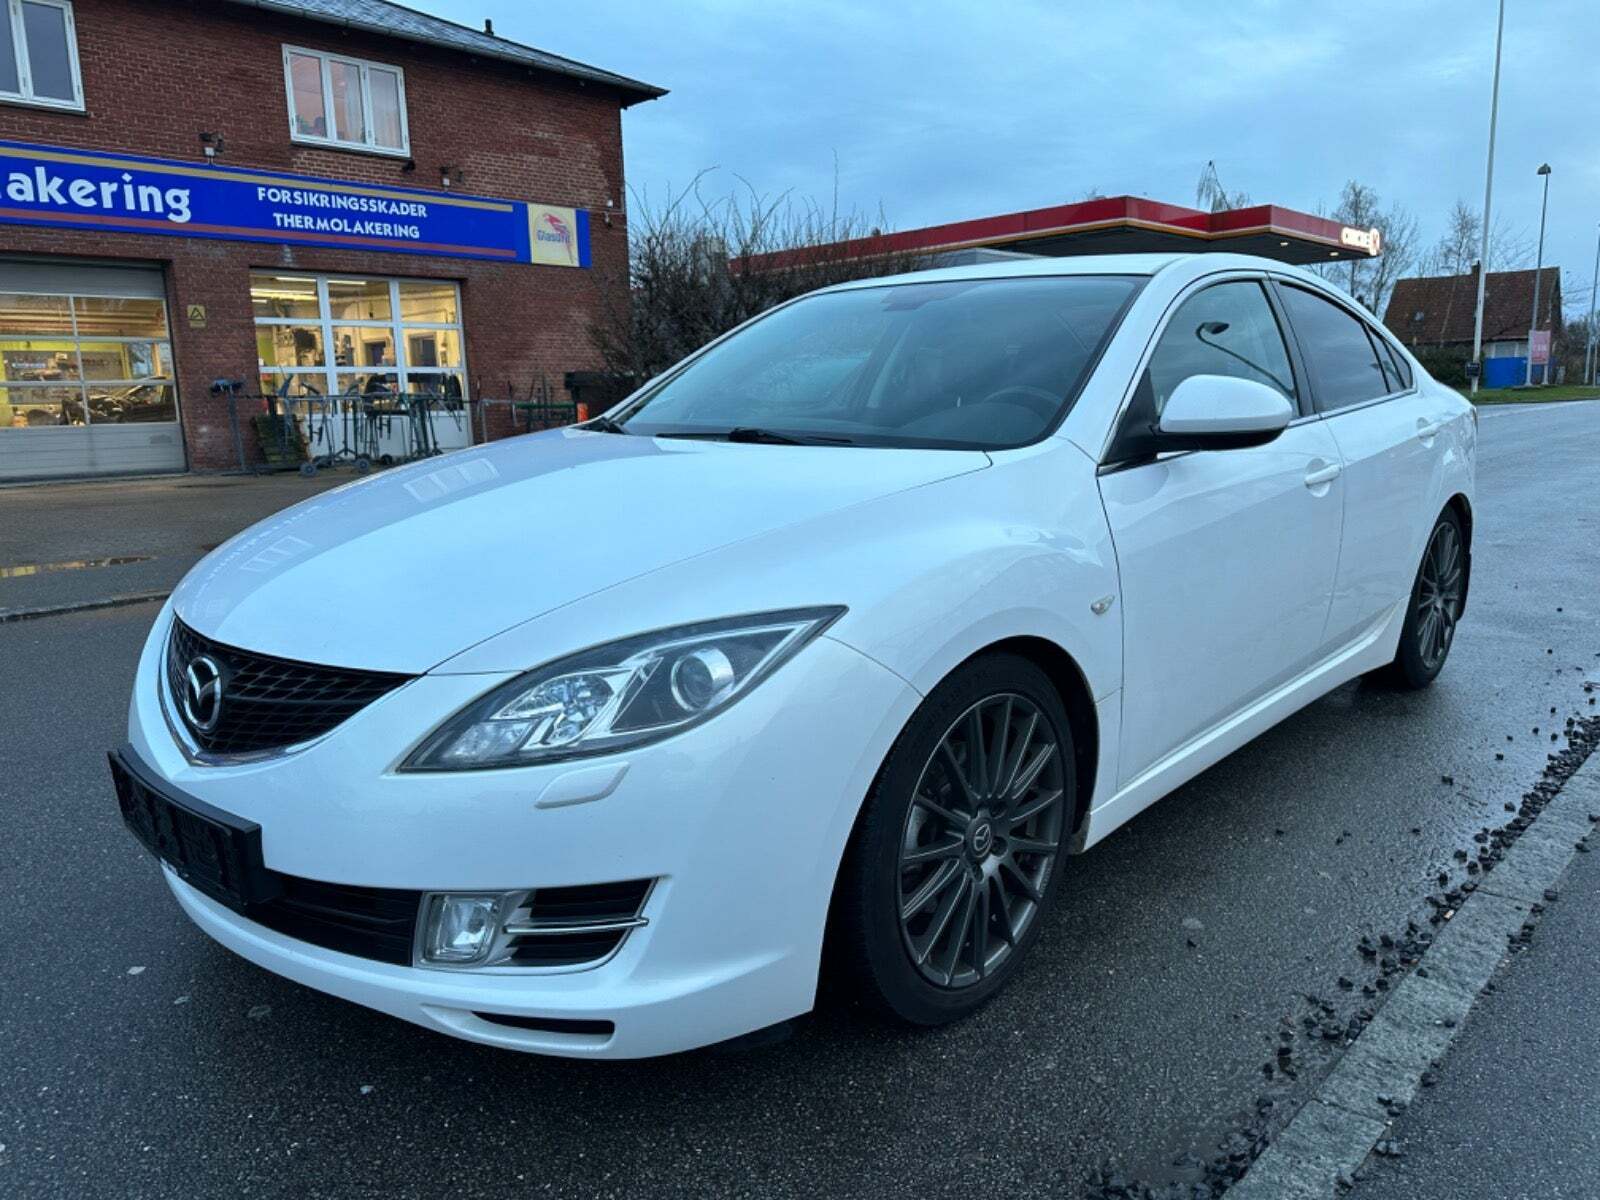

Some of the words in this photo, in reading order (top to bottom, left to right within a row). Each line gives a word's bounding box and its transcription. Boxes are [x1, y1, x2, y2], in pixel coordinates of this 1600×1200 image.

[0, 166, 192, 223] akering
[257, 186, 428, 218] FORSIKRINGSSKADER
[273, 212, 420, 239] THERMOLAKERING
